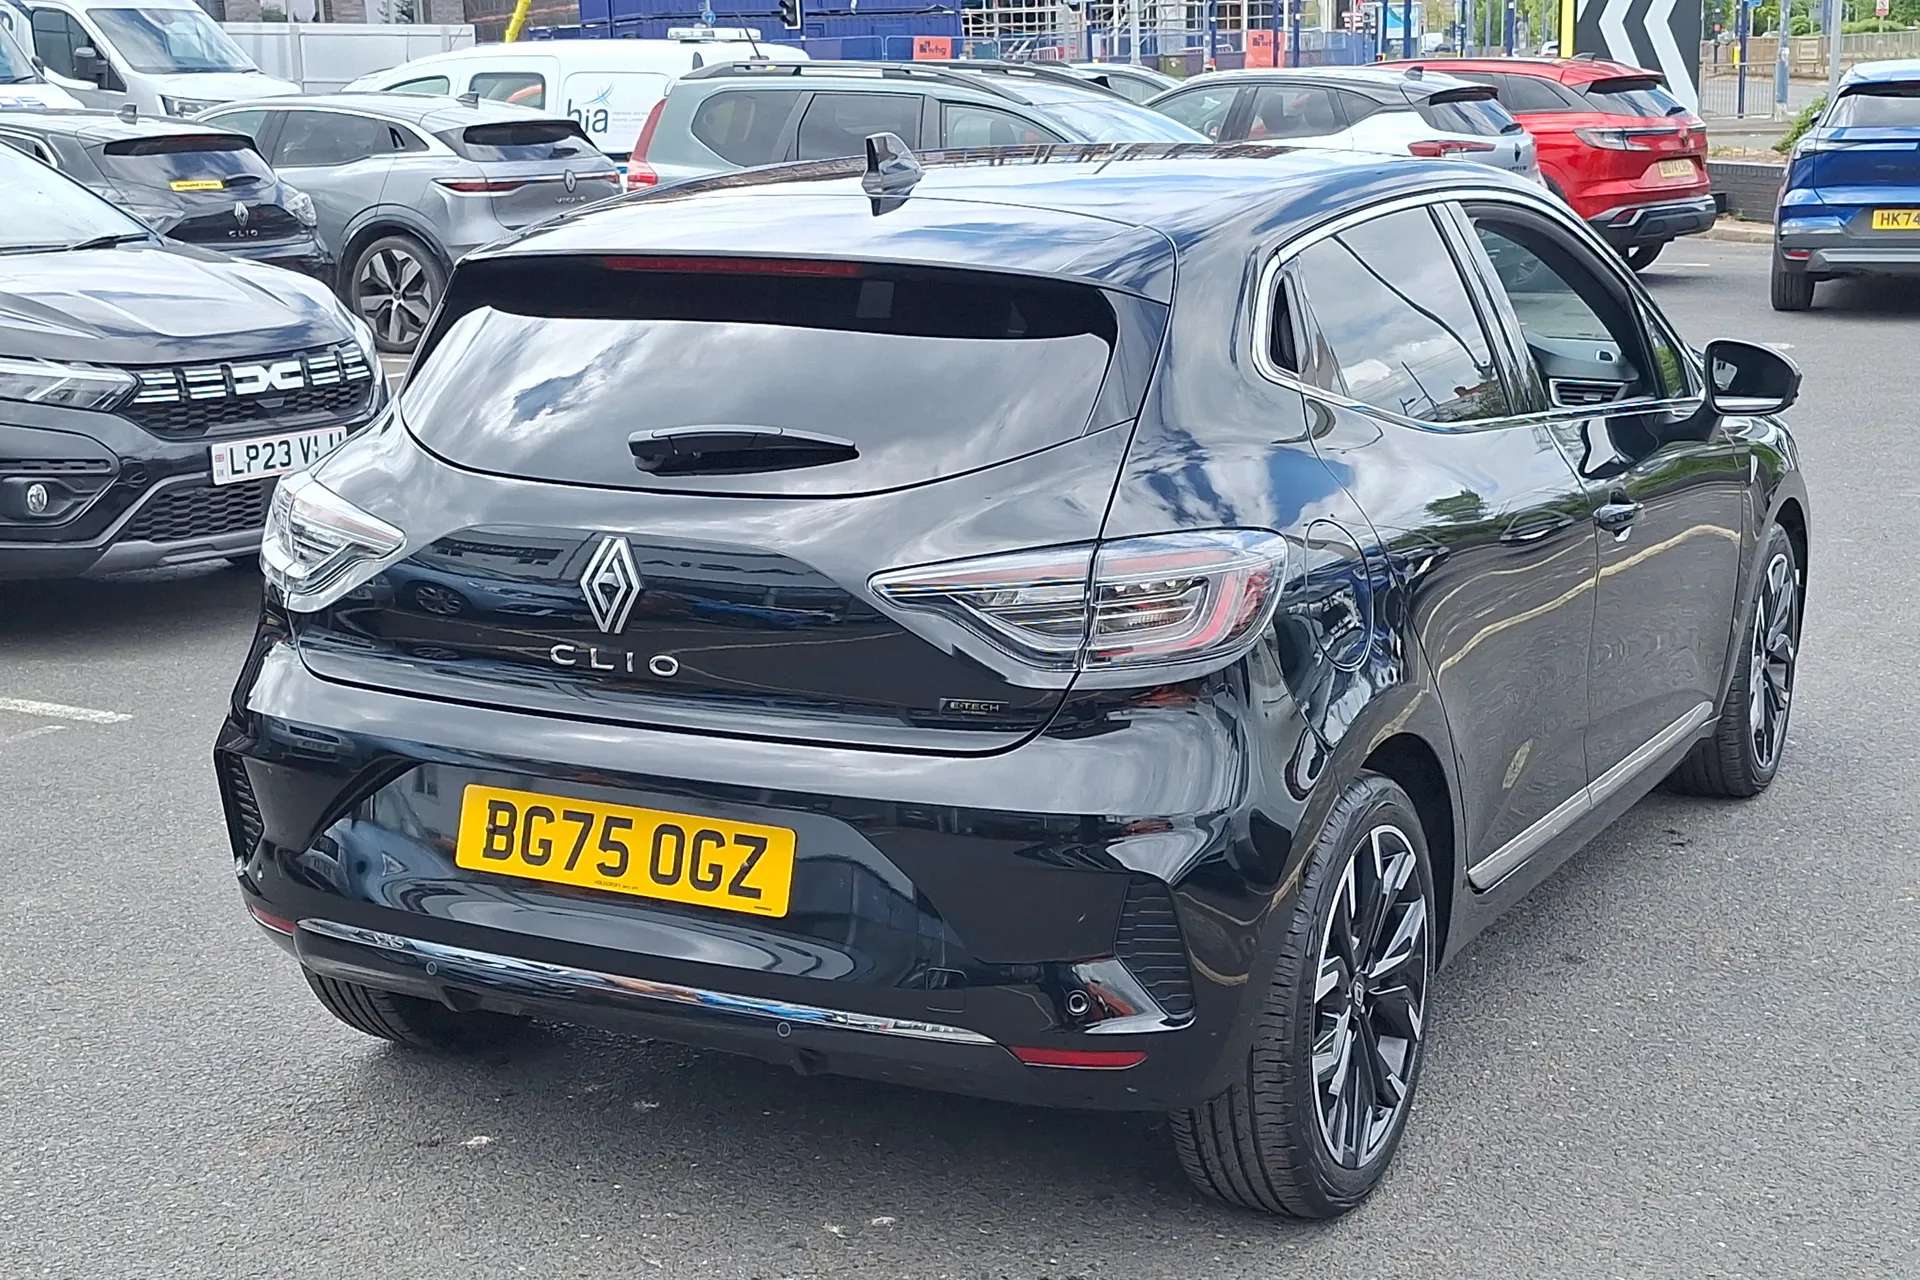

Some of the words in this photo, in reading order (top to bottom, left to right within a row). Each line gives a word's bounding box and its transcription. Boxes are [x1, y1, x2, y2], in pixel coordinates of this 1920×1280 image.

[228, 229, 259, 238] CLIO
[229, 439, 292, 475] LP23
[550, 644, 679, 677] CLIO
[482, 799, 634, 878] BG75
[649, 823, 768, 900] OGZ
